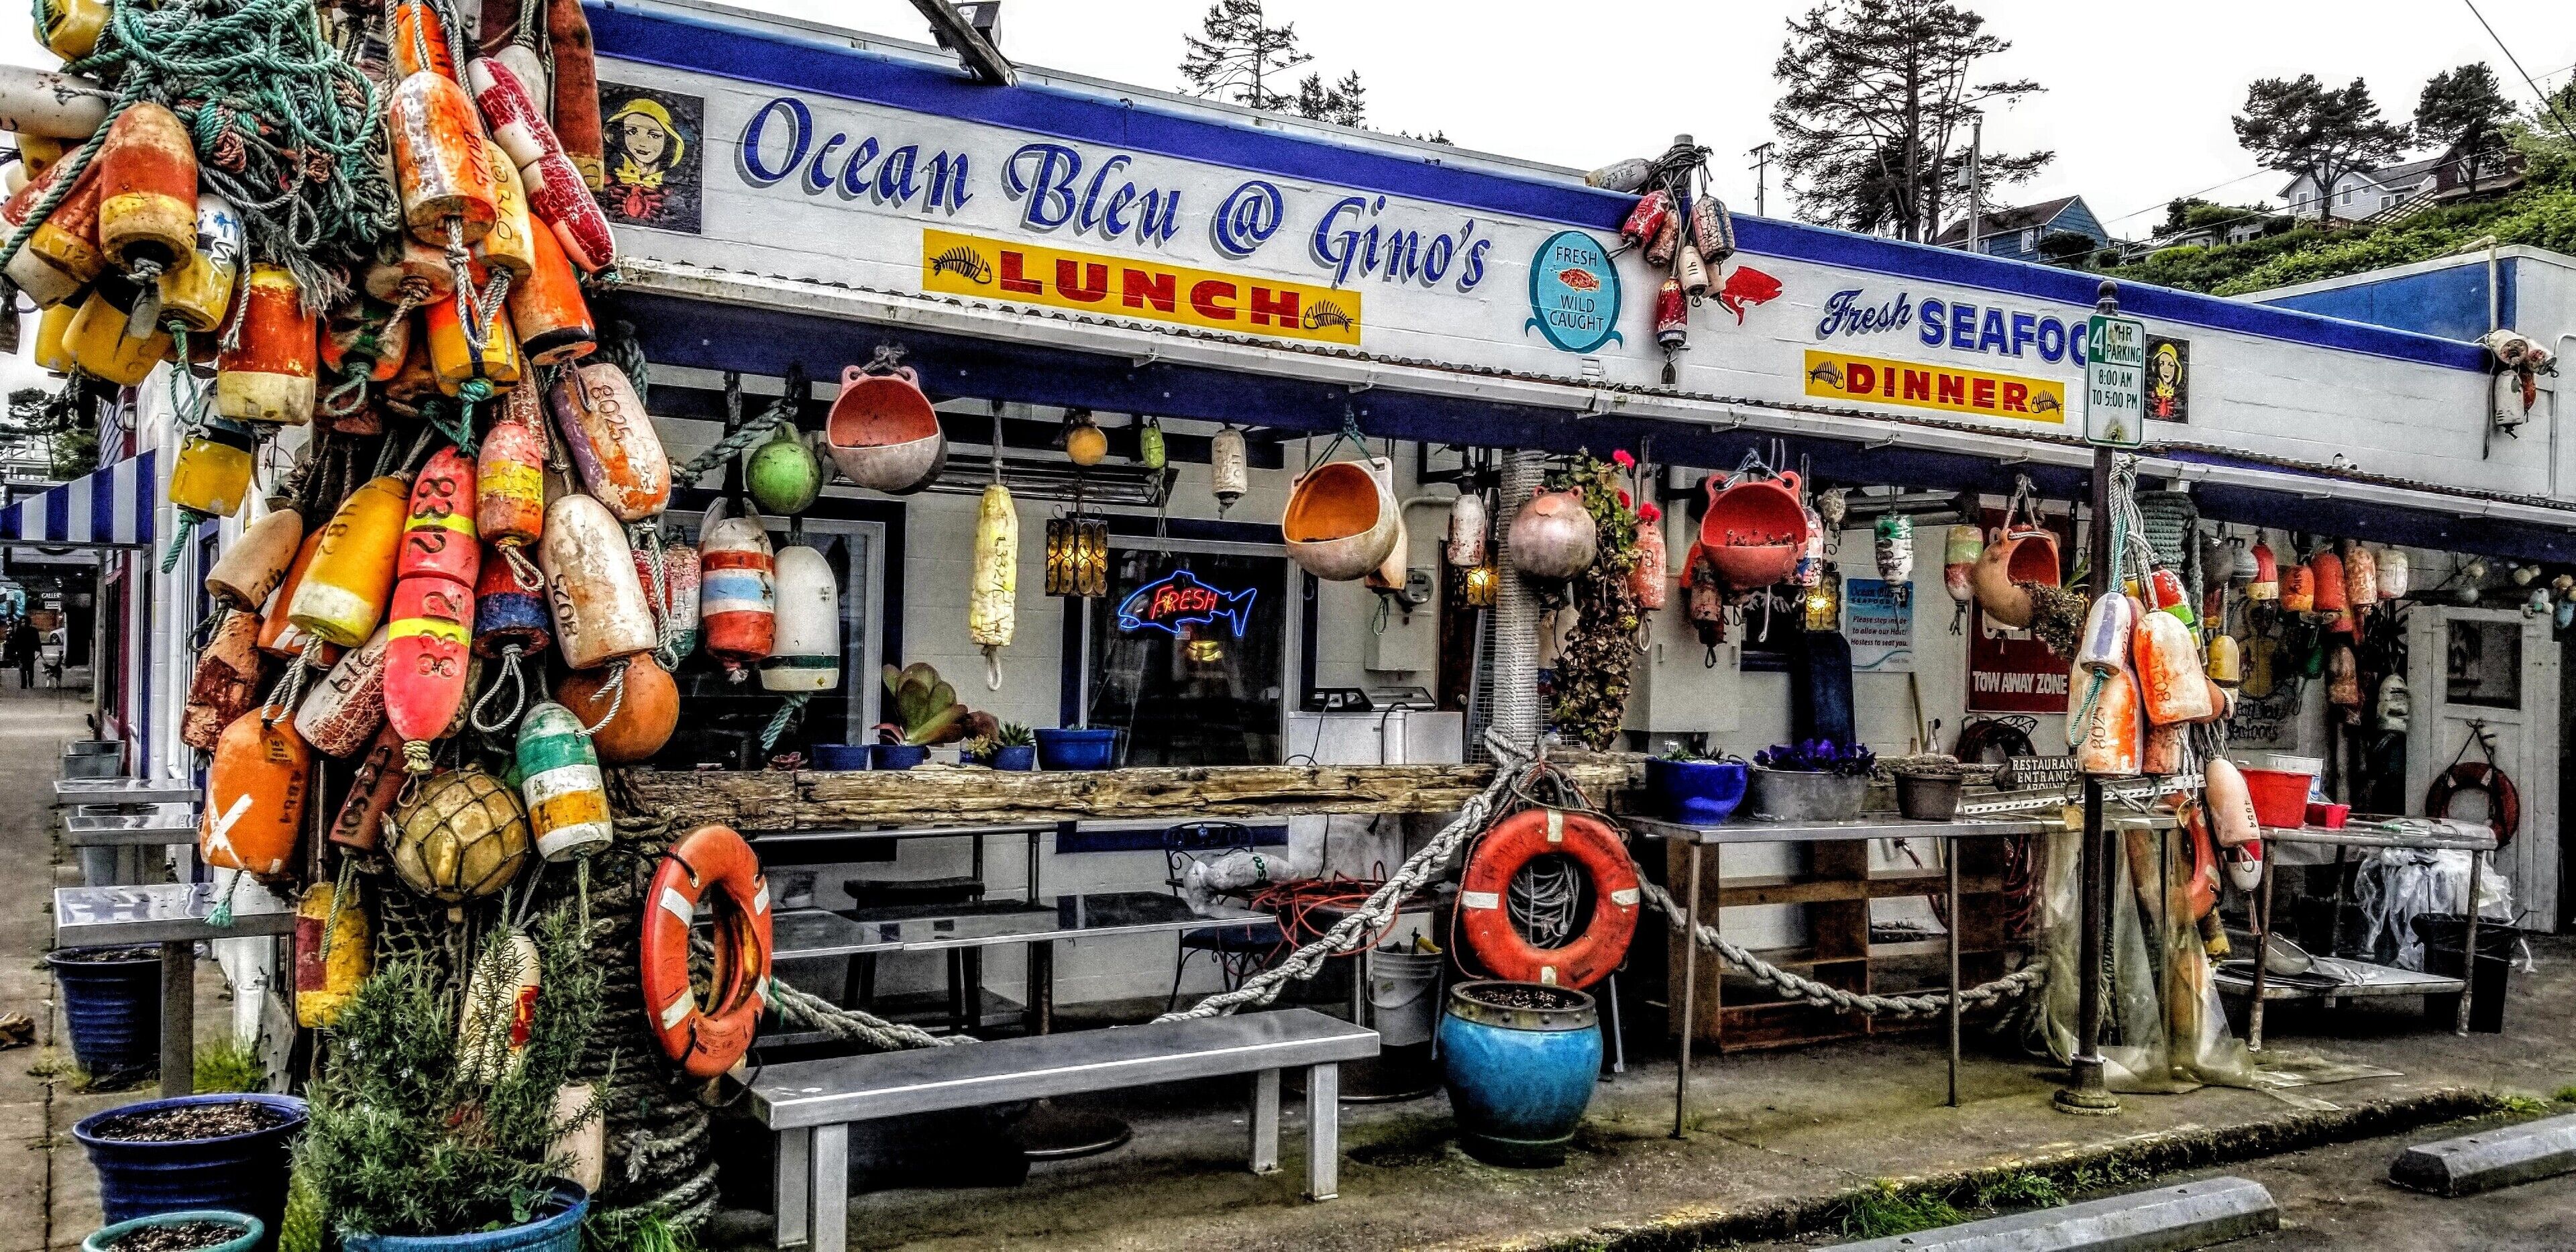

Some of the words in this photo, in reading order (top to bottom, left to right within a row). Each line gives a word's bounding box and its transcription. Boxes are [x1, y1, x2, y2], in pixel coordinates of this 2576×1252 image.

[734, 97, 974, 217] Ocean
[1000, 143, 1182, 249] Bleu
[1209, 180, 1284, 260] @
[1308, 194, 1491, 294] Gino's
[1556, 246, 1598, 267] FRESH
[1000, 251, 1299, 329] LUNCH
[1560, 295, 1595, 313] WILD
[1550, 311, 1604, 333] CAUGHT
[1815, 289, 1913, 341] Fresh
[1918, 297, 2086, 368] SEAFOO
[2091, 325, 2104, 356] 4
[2118, 325, 2133, 342] HR
[2106, 344, 2141, 363] PARKING
[1846, 362, 2029, 413] DINNER
[2098, 369, 2117, 386] 8:00
[2120, 372, 2133, 388] AM
[2092, 389, 2102, 405] TO
[2105, 390, 2124, 408] 5:00
[2127, 393, 2138, 409] PM
[1150, 584, 1218, 620] FRESH
[1852, 615, 1873, 623] Please
[1874, 617, 1887, 625] step
[1972, 671, 2000, 692] TOW
[2001, 672, 2035, 693] AWAY
[2036, 674, 2068, 694] ZONE
[2012, 758, 2078, 771] RESTAURANT
[1252, 856, 1266, 882] SCO
